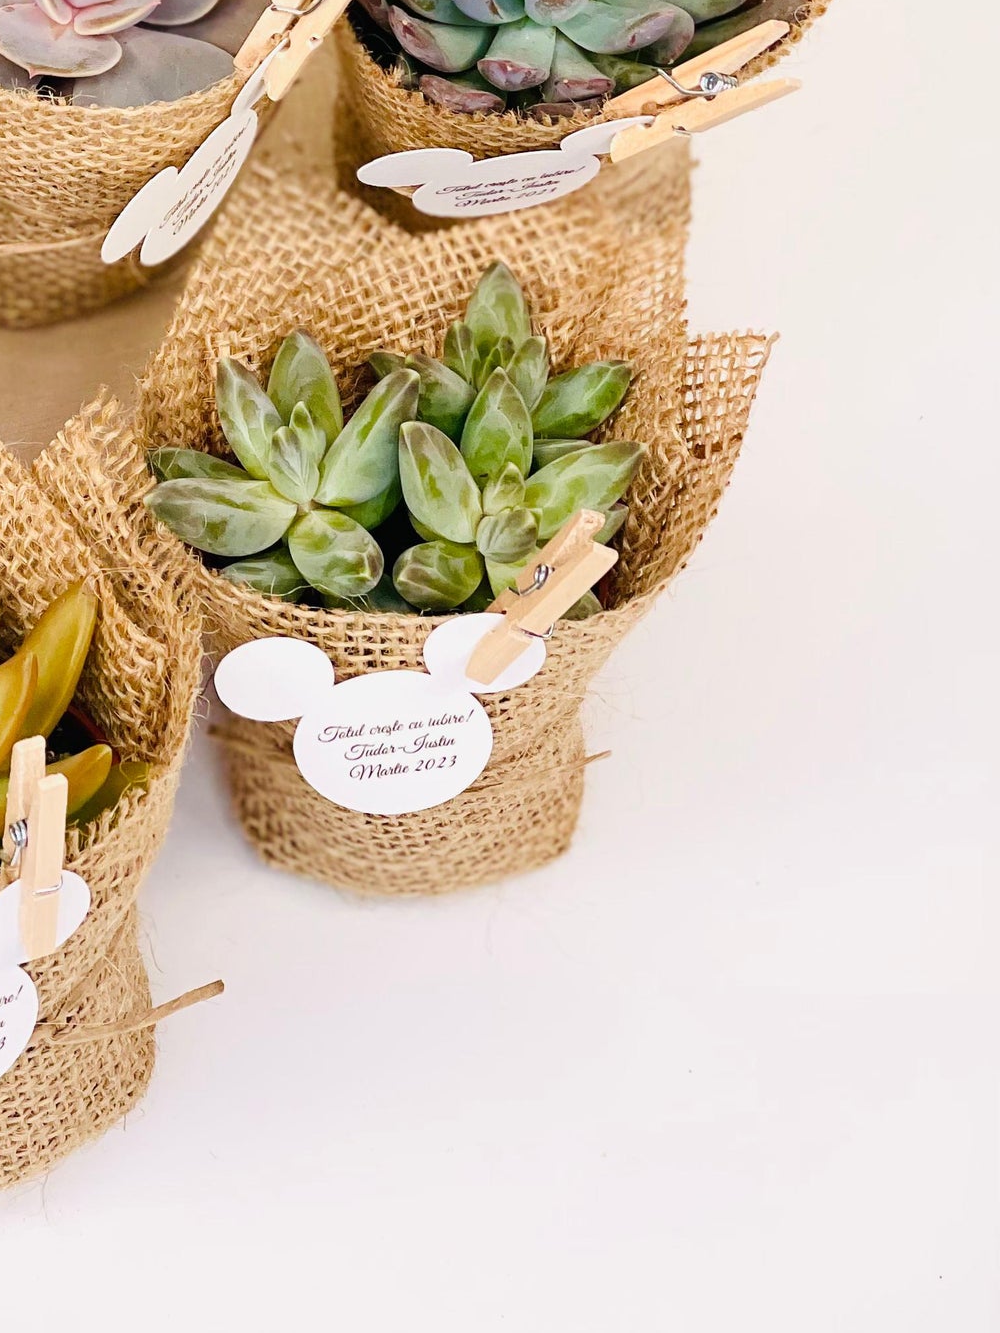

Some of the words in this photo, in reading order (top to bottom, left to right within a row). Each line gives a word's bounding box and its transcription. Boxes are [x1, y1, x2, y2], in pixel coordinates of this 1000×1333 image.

[317, 723, 366, 743] Totul
[408, 720, 424, 731] cu
[427, 709, 474, 728] iubire!
[344, 733, 456, 761] Tudor-Iustin
[349, 763, 410, 781] Martie
[414, 755, 457, 772] 2023
